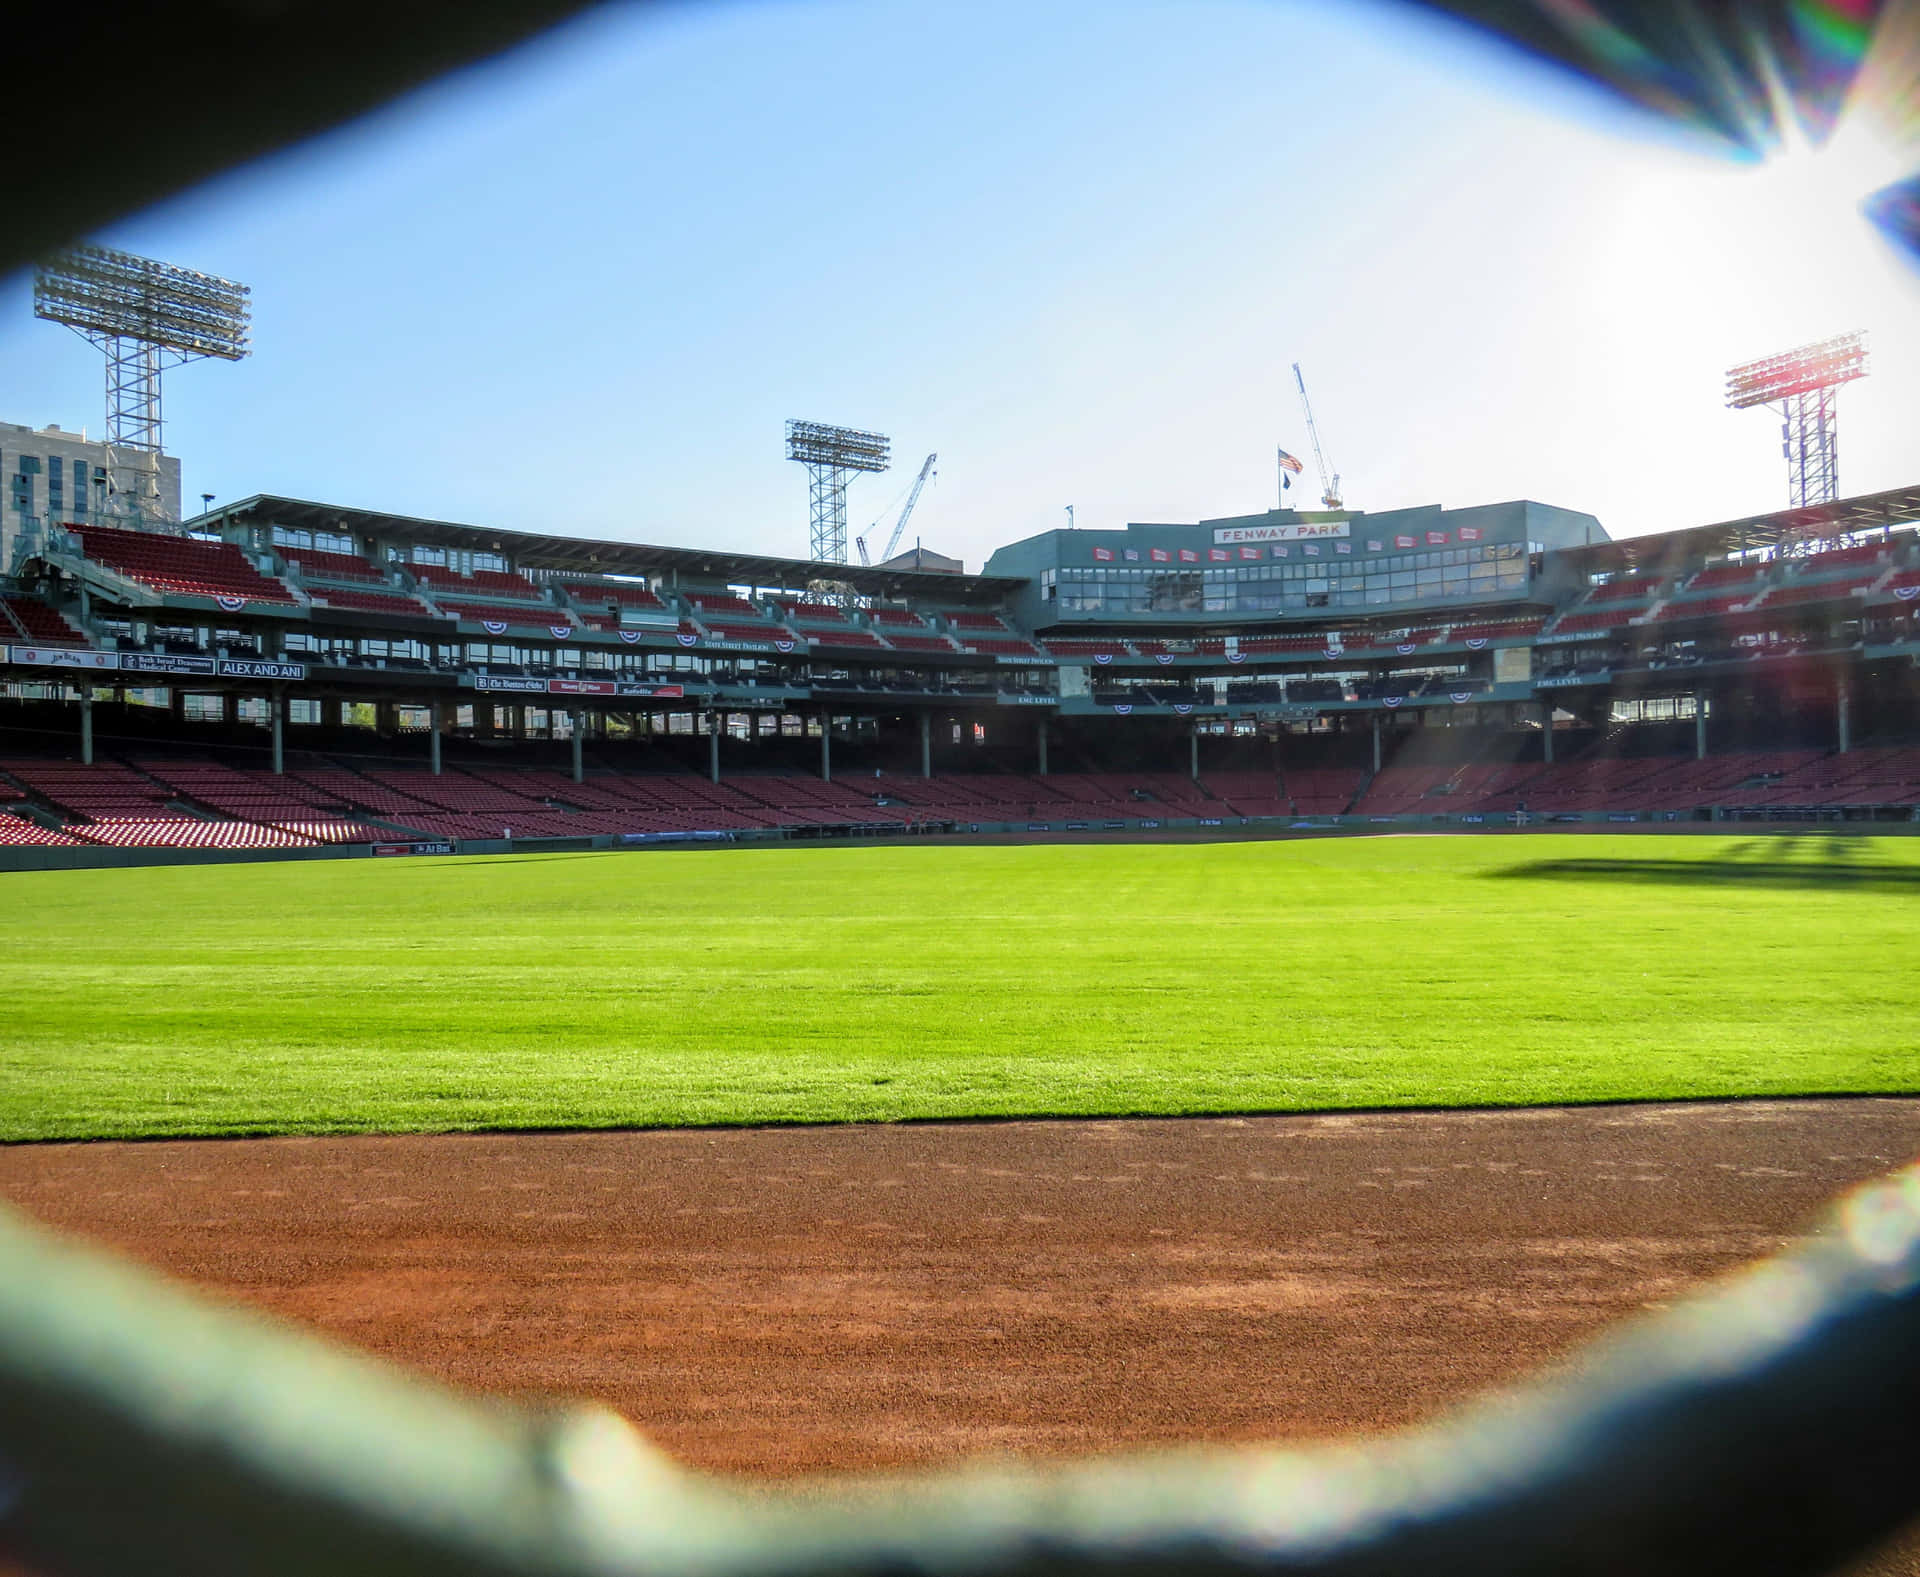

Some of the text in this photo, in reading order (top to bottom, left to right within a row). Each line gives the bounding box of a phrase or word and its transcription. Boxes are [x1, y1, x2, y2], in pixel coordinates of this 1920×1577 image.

[1223, 525, 1341, 541] FENWAY PARK
[223, 662, 301, 677] ALEX AND ANI
[490, 680, 543, 689] The Boston Globe
